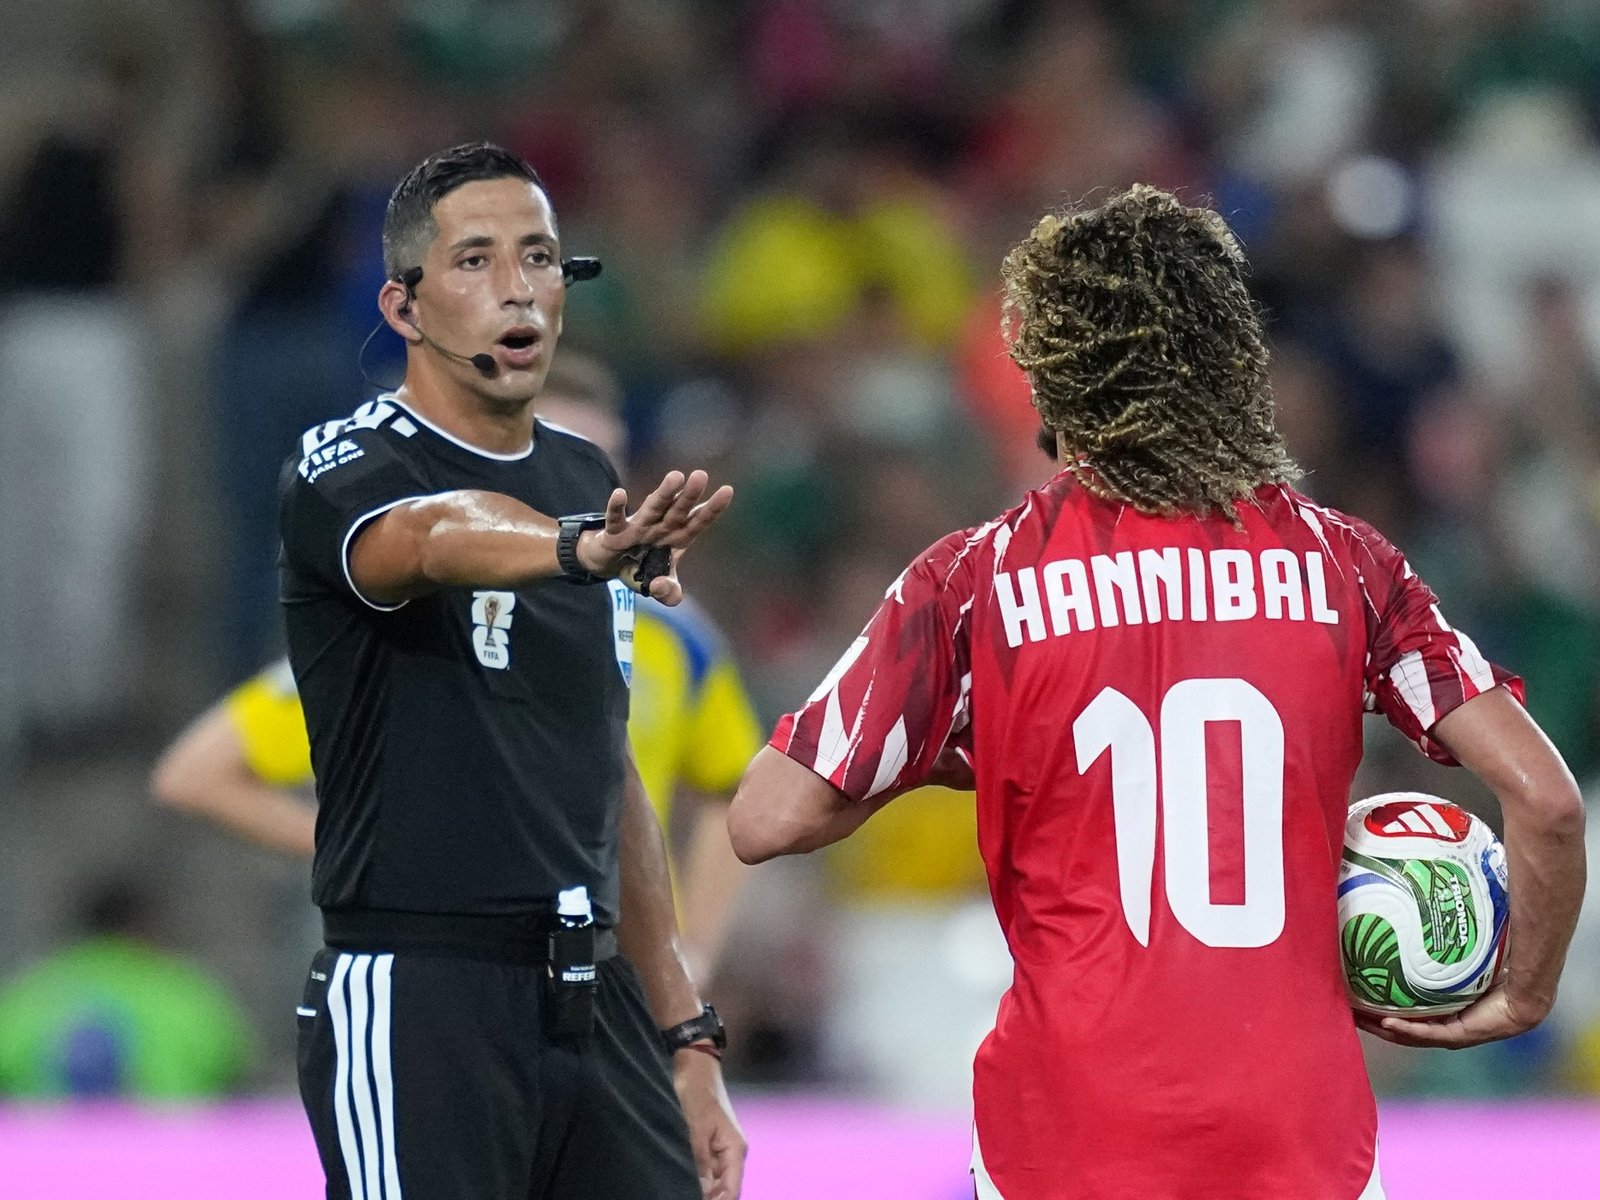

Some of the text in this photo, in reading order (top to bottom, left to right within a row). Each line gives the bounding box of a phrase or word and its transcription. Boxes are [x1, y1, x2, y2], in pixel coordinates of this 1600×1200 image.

[298, 439, 359, 478] FIFA
[308, 449, 365, 484] TEAM ONE
[615, 588, 636, 611] FIF
[994, 547, 1339, 648] HANNIBAL
[618, 630, 634, 643] REFE
[483, 650, 499, 661] FIFA
[1072, 678, 1286, 948] 10
[1450, 874, 1469, 948] TRIONDA
